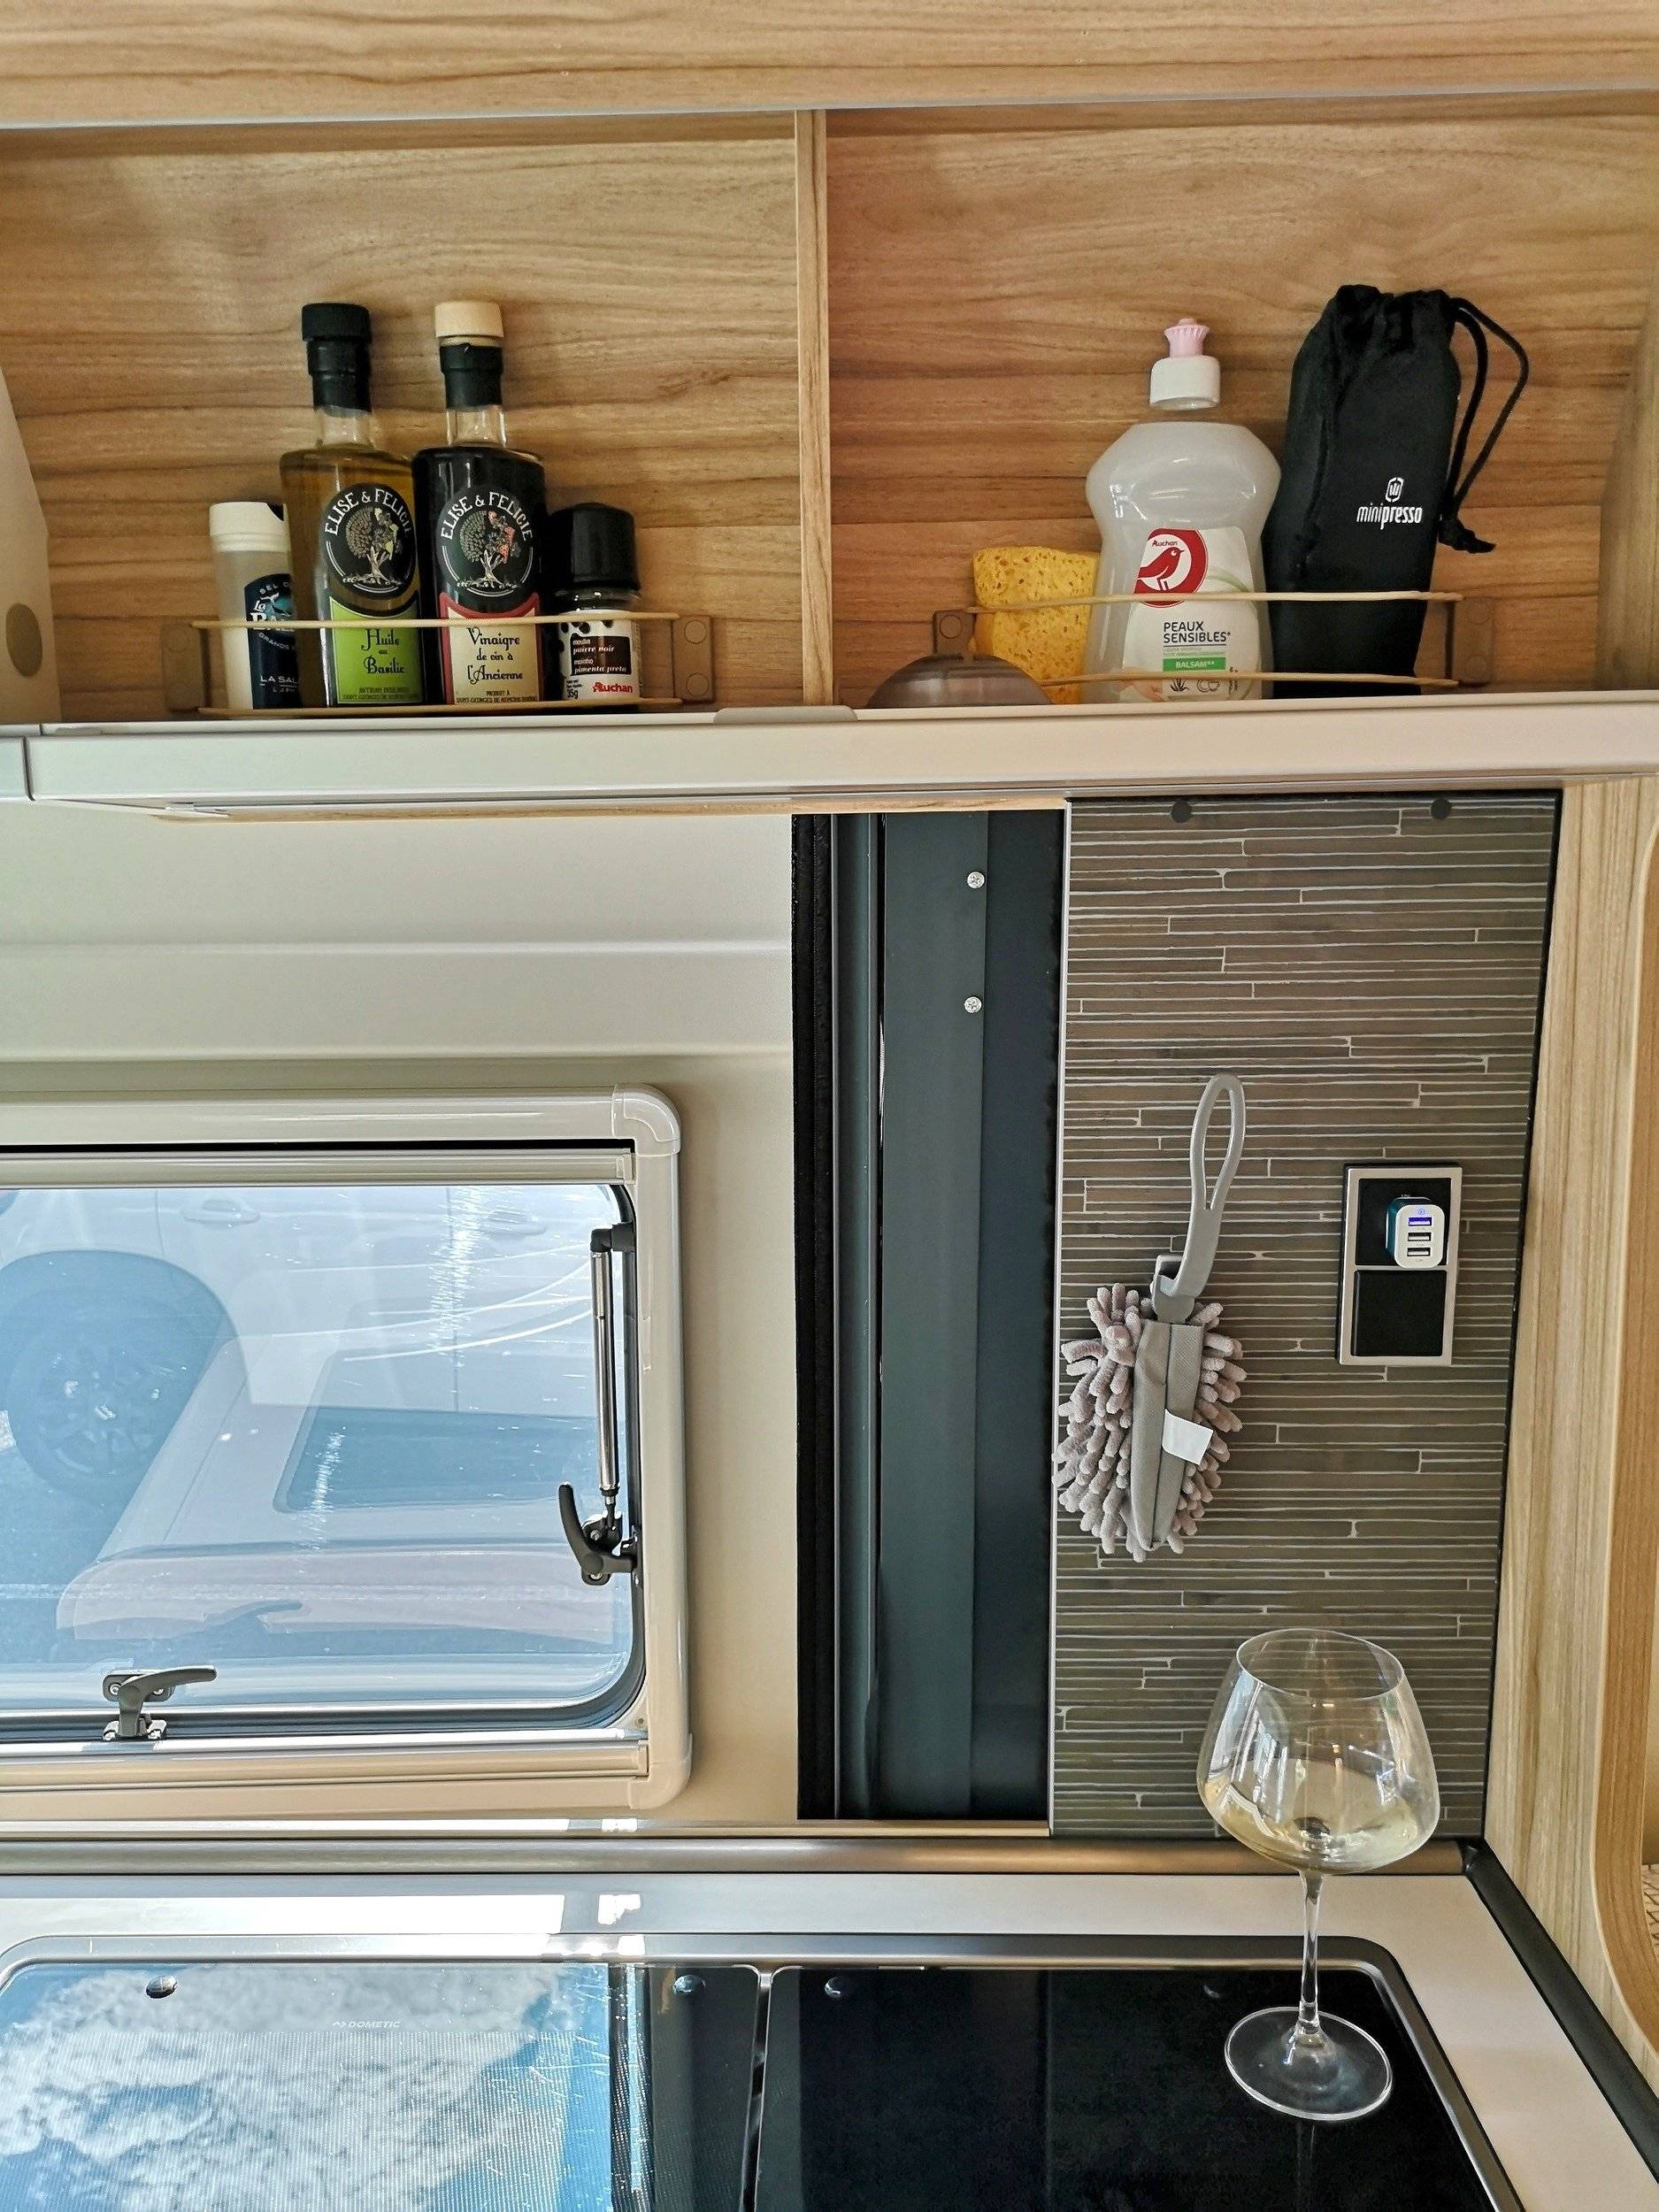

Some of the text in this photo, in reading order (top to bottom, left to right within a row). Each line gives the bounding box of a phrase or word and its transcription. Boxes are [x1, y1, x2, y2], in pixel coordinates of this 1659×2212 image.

[325, 492, 359, 535] ELISE
[361, 490, 371, 503] &
[441, 491, 533, 541] ELISE & FELICIE
[1356, 503, 1423, 530] minipresso
[1164, 621, 1203, 632] PEAUX
[361, 627, 400, 651] Huile
[467, 626, 520, 650] Vinaigre
[363, 655, 404, 674] Basilic
[476, 648, 487, 660] de
[467, 664, 523, 685] l'Ancienne
[593, 682, 633, 693] Auchan
